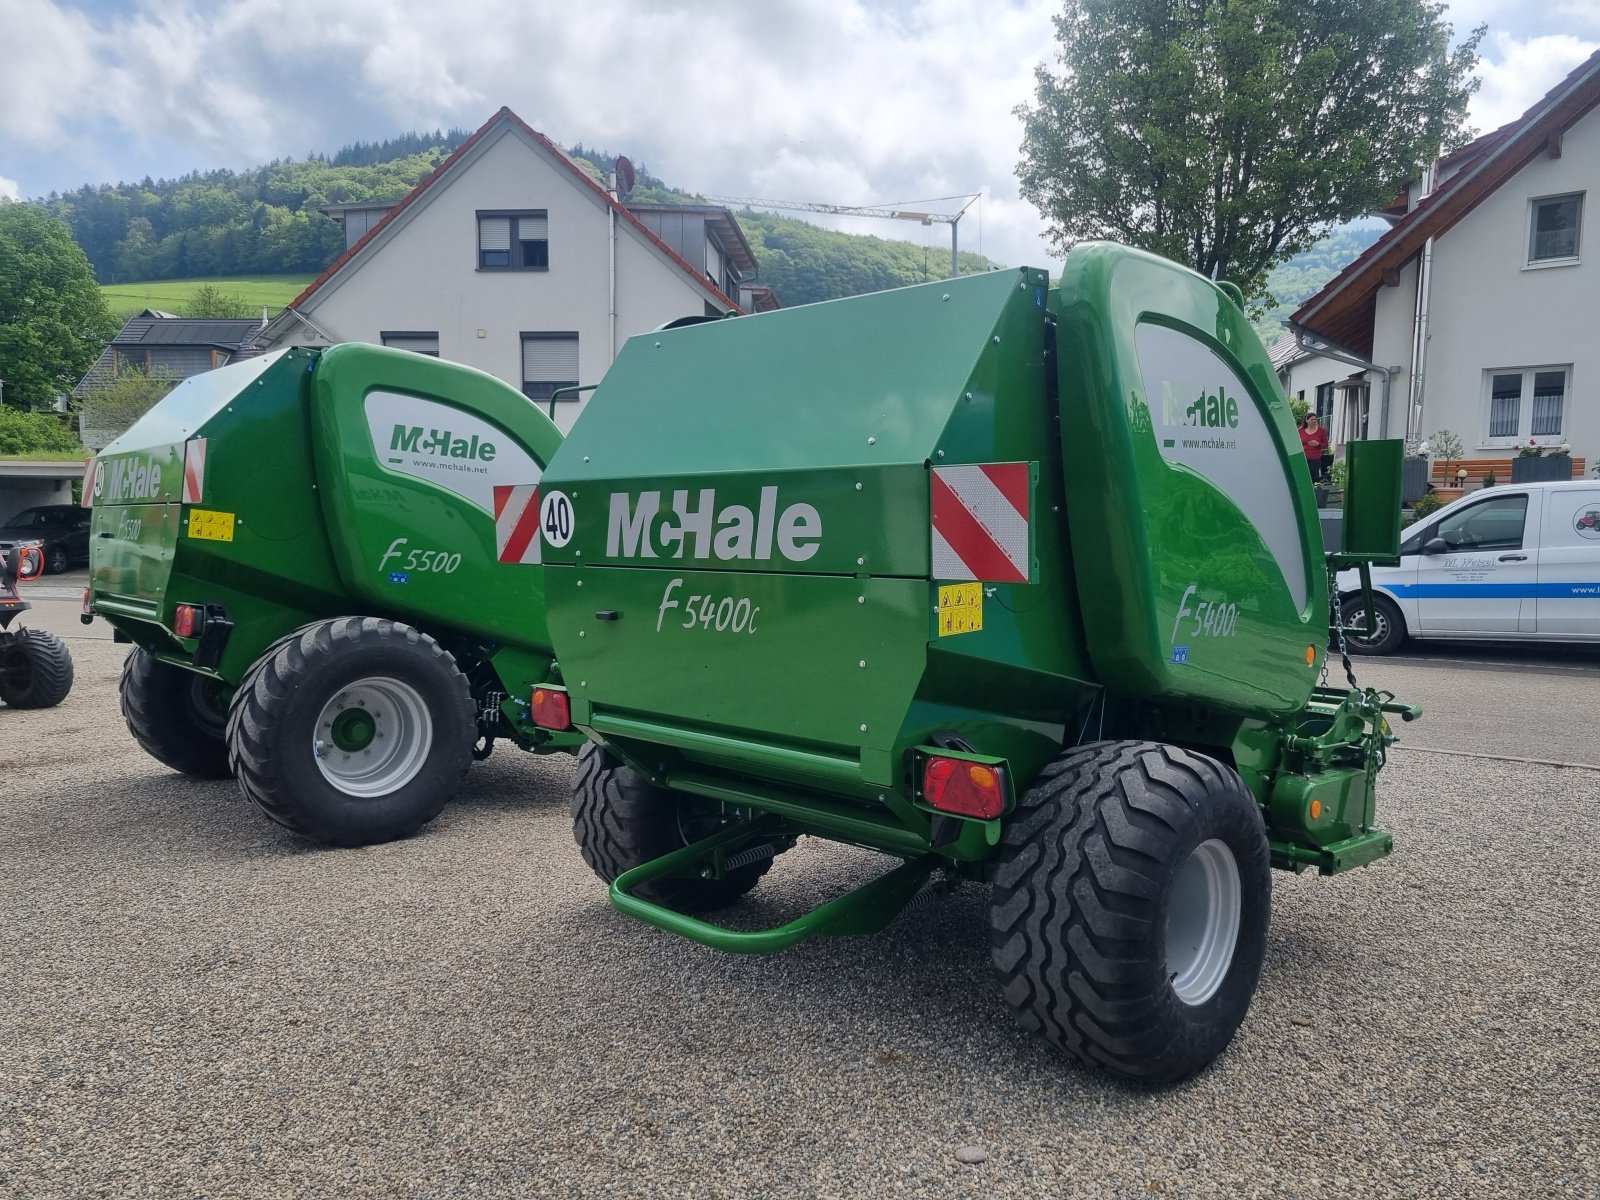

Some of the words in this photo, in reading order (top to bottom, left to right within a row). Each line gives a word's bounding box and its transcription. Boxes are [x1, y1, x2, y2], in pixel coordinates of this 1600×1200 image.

[390, 424, 496, 462] McHale
[1181, 437, 1237, 450] www.mchale.net
[109, 456, 161, 499] McHale
[413, 460, 488, 474] www.mchale.net
[545, 497, 569, 541] 40
[606, 486, 823, 561] McHale
